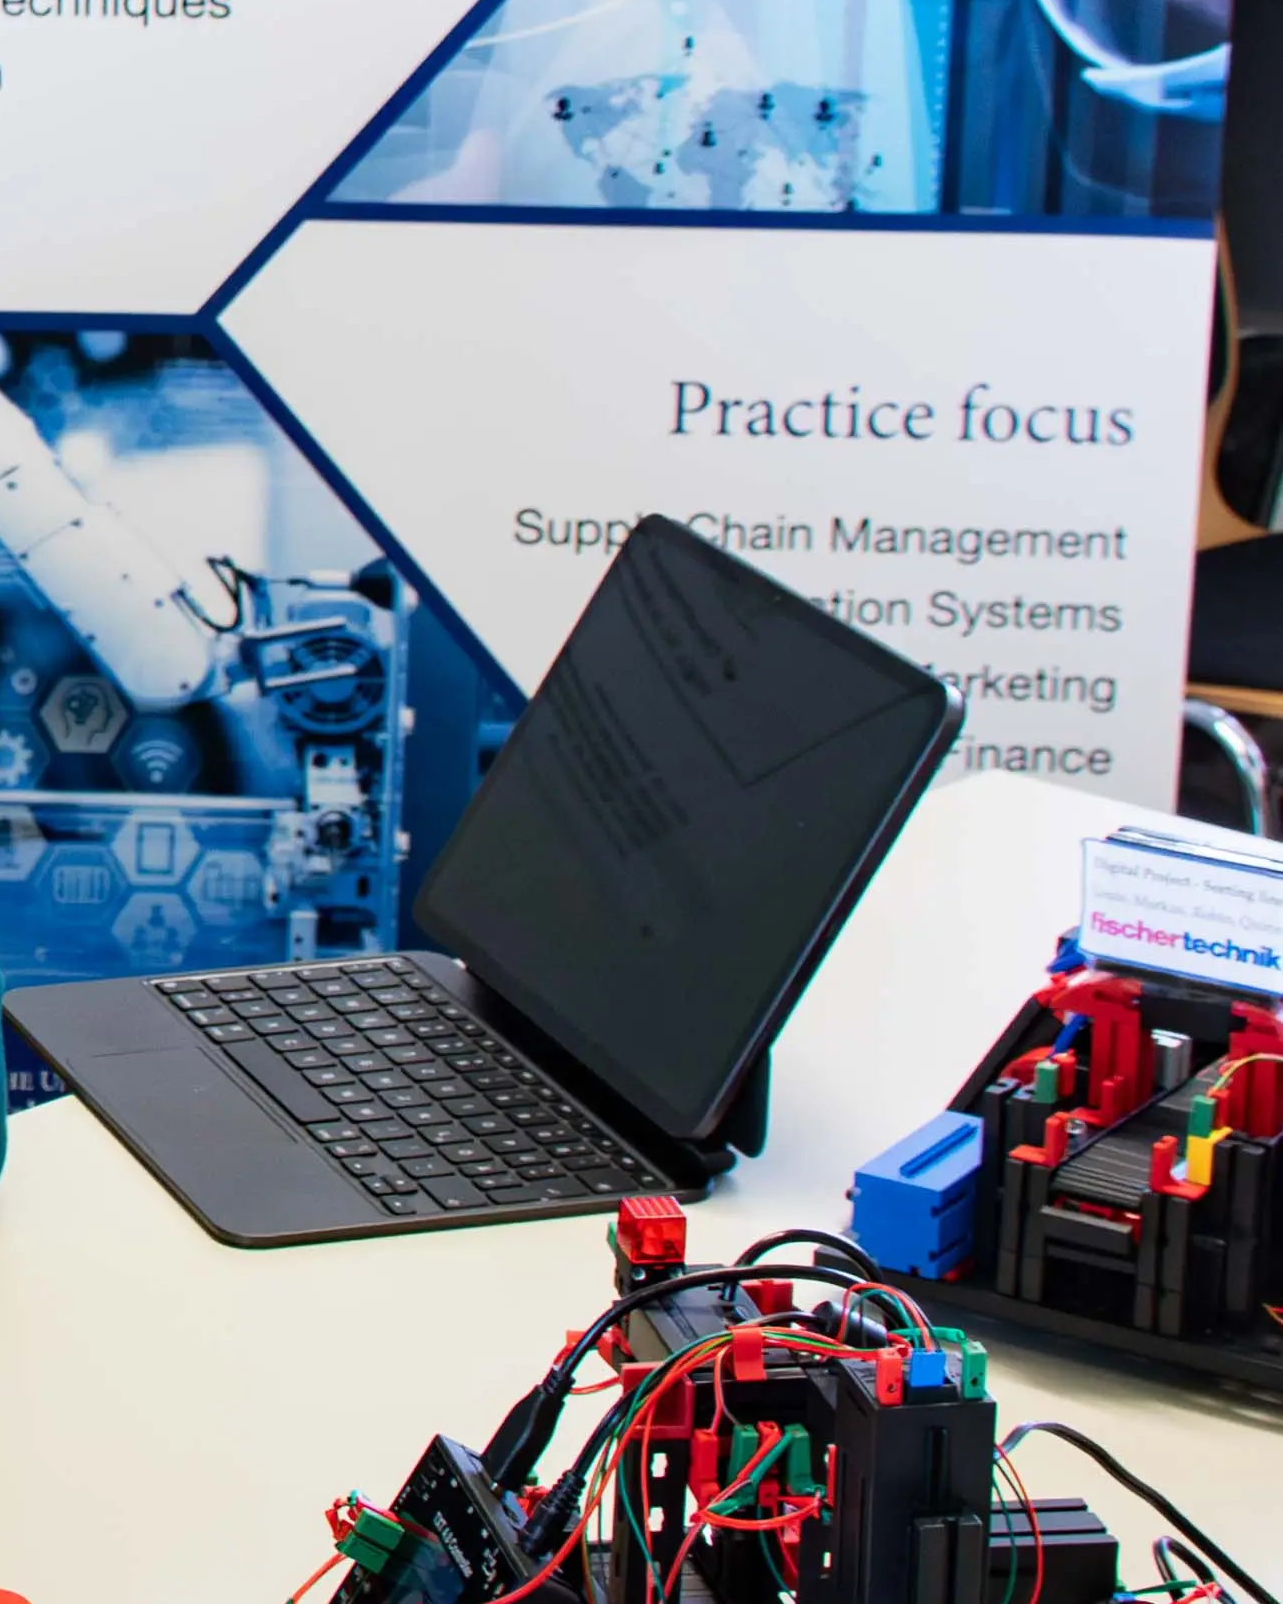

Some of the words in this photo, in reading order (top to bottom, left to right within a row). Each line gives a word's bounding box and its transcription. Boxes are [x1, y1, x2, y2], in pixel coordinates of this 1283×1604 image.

[669, 380, 936, 443] Practice
[956, 384, 1136, 447] focus
[831, 515, 1127, 565] Management
[927, 590, 1124, 637] Systems
[921, 662, 1118, 713] arketing
[952, 735, 1114, 776] inance
[1093, 911, 1282, 970] fischertechnik
